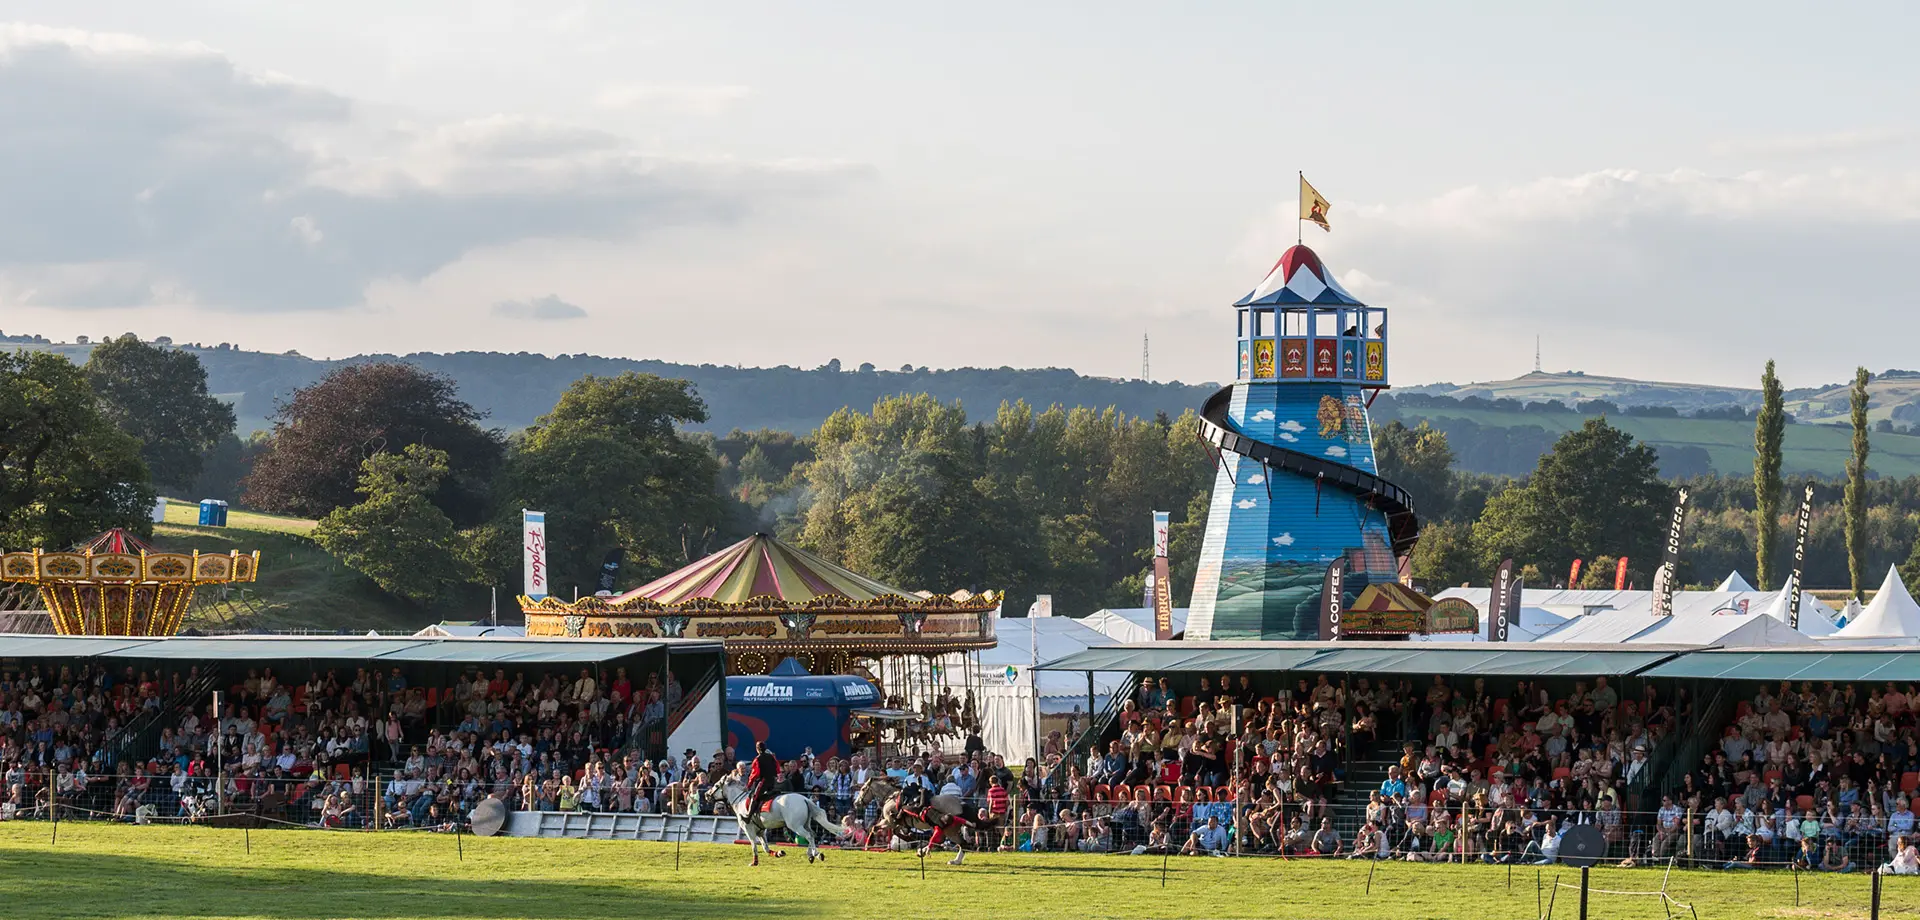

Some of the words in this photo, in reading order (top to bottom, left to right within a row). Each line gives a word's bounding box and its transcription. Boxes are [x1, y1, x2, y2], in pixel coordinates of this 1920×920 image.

[527, 527, 547, 591] Rydale
[1668, 506, 1683, 555] GUNDOG
[1795, 502, 1811, 561] MUNTJAC
[1330, 567, 1341, 624] COFFEE
[1497, 569, 1509, 641] OOTHIES
[1790, 569, 1801, 628] TRADING
[743, 682, 794, 697] LAVAZZA
[842, 682, 873, 697] LAVAZZA
